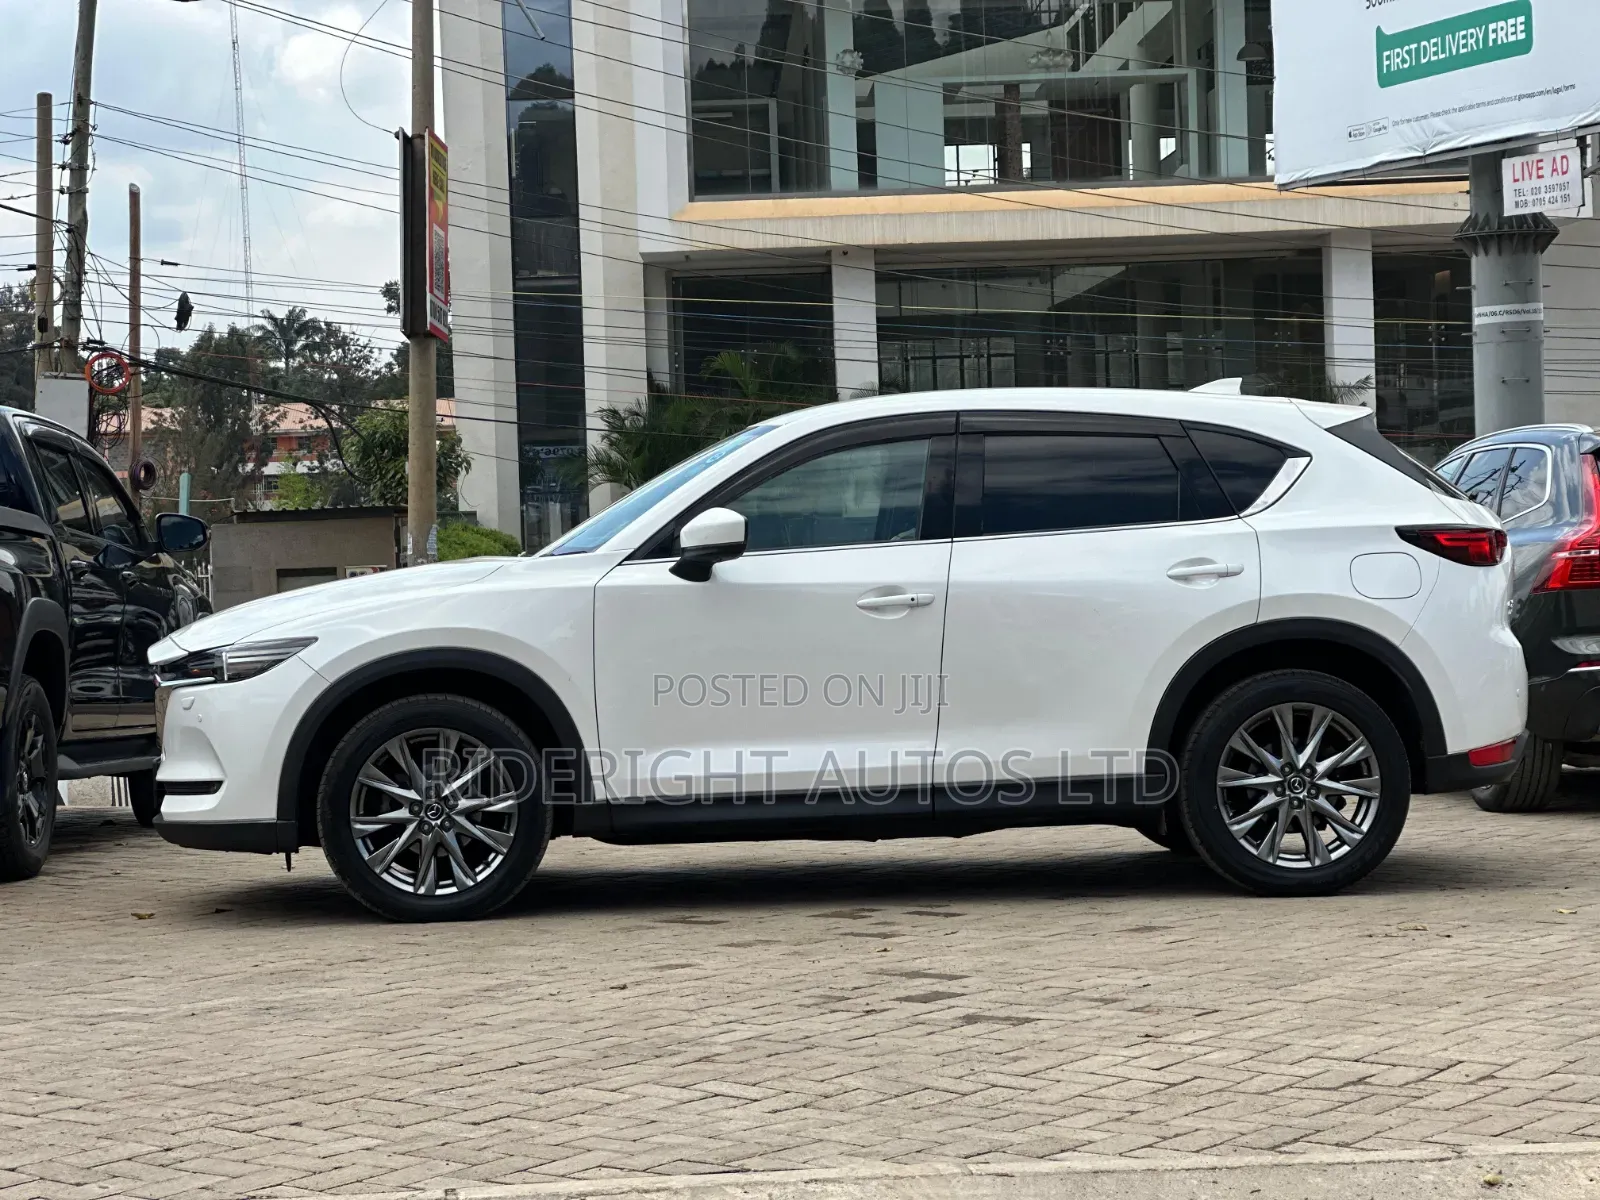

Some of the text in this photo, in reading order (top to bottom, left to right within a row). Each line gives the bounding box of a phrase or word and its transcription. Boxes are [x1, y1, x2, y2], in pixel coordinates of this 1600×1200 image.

[1382, 15, 1526, 74] FIRST DELIVERY FREE
[1512, 154, 1569, 183] LIVE AD
[1513, 188, 1529, 198] TEL:
[1530, 186, 1542, 196] 020
[1547, 195, 1559, 204] 424
[1560, 193, 1571, 203] 151
